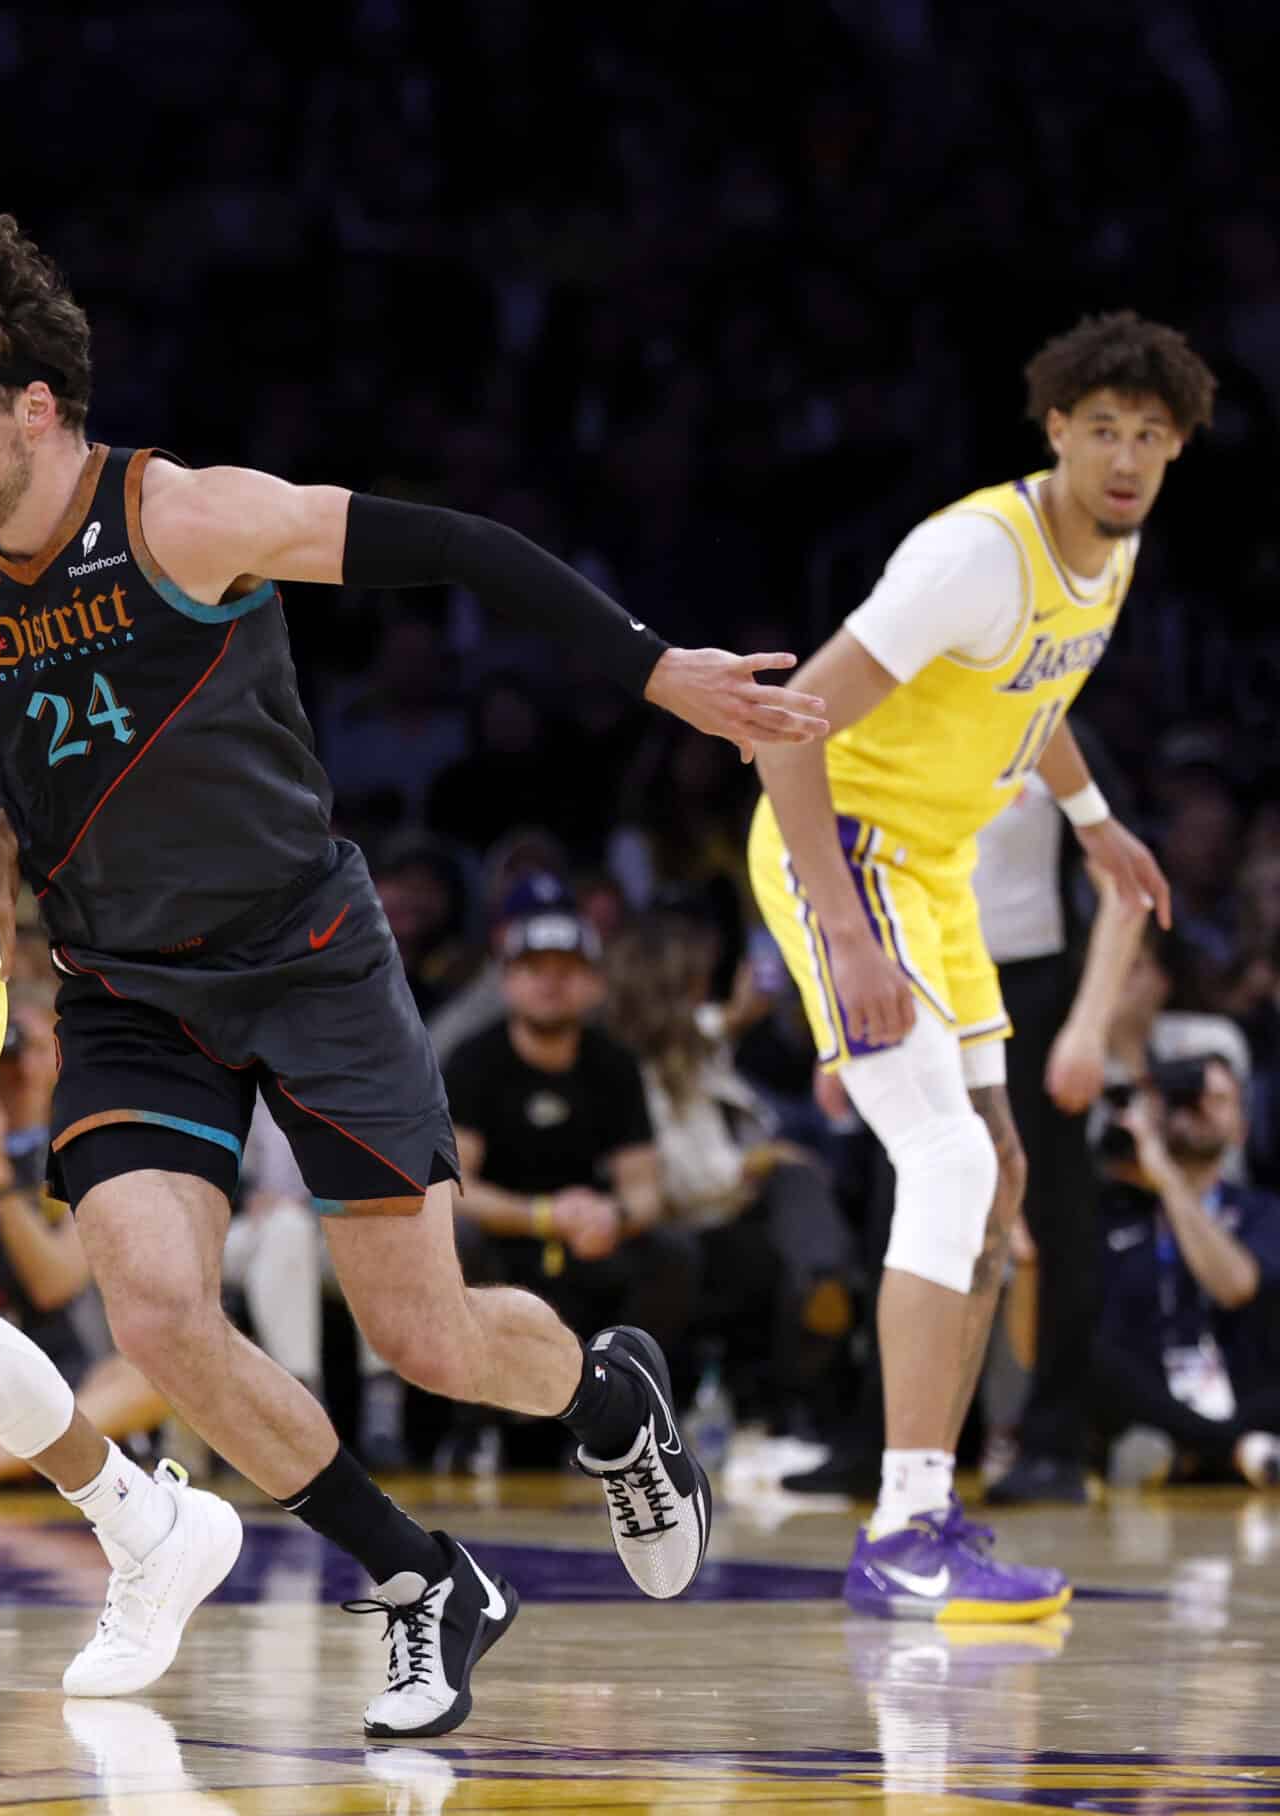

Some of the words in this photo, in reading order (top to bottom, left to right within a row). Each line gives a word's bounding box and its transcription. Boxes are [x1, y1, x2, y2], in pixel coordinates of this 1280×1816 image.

[68, 552, 128, 577] Robinhood
[26, 672, 136, 768] 24
[992, 694, 1066, 788] 11
